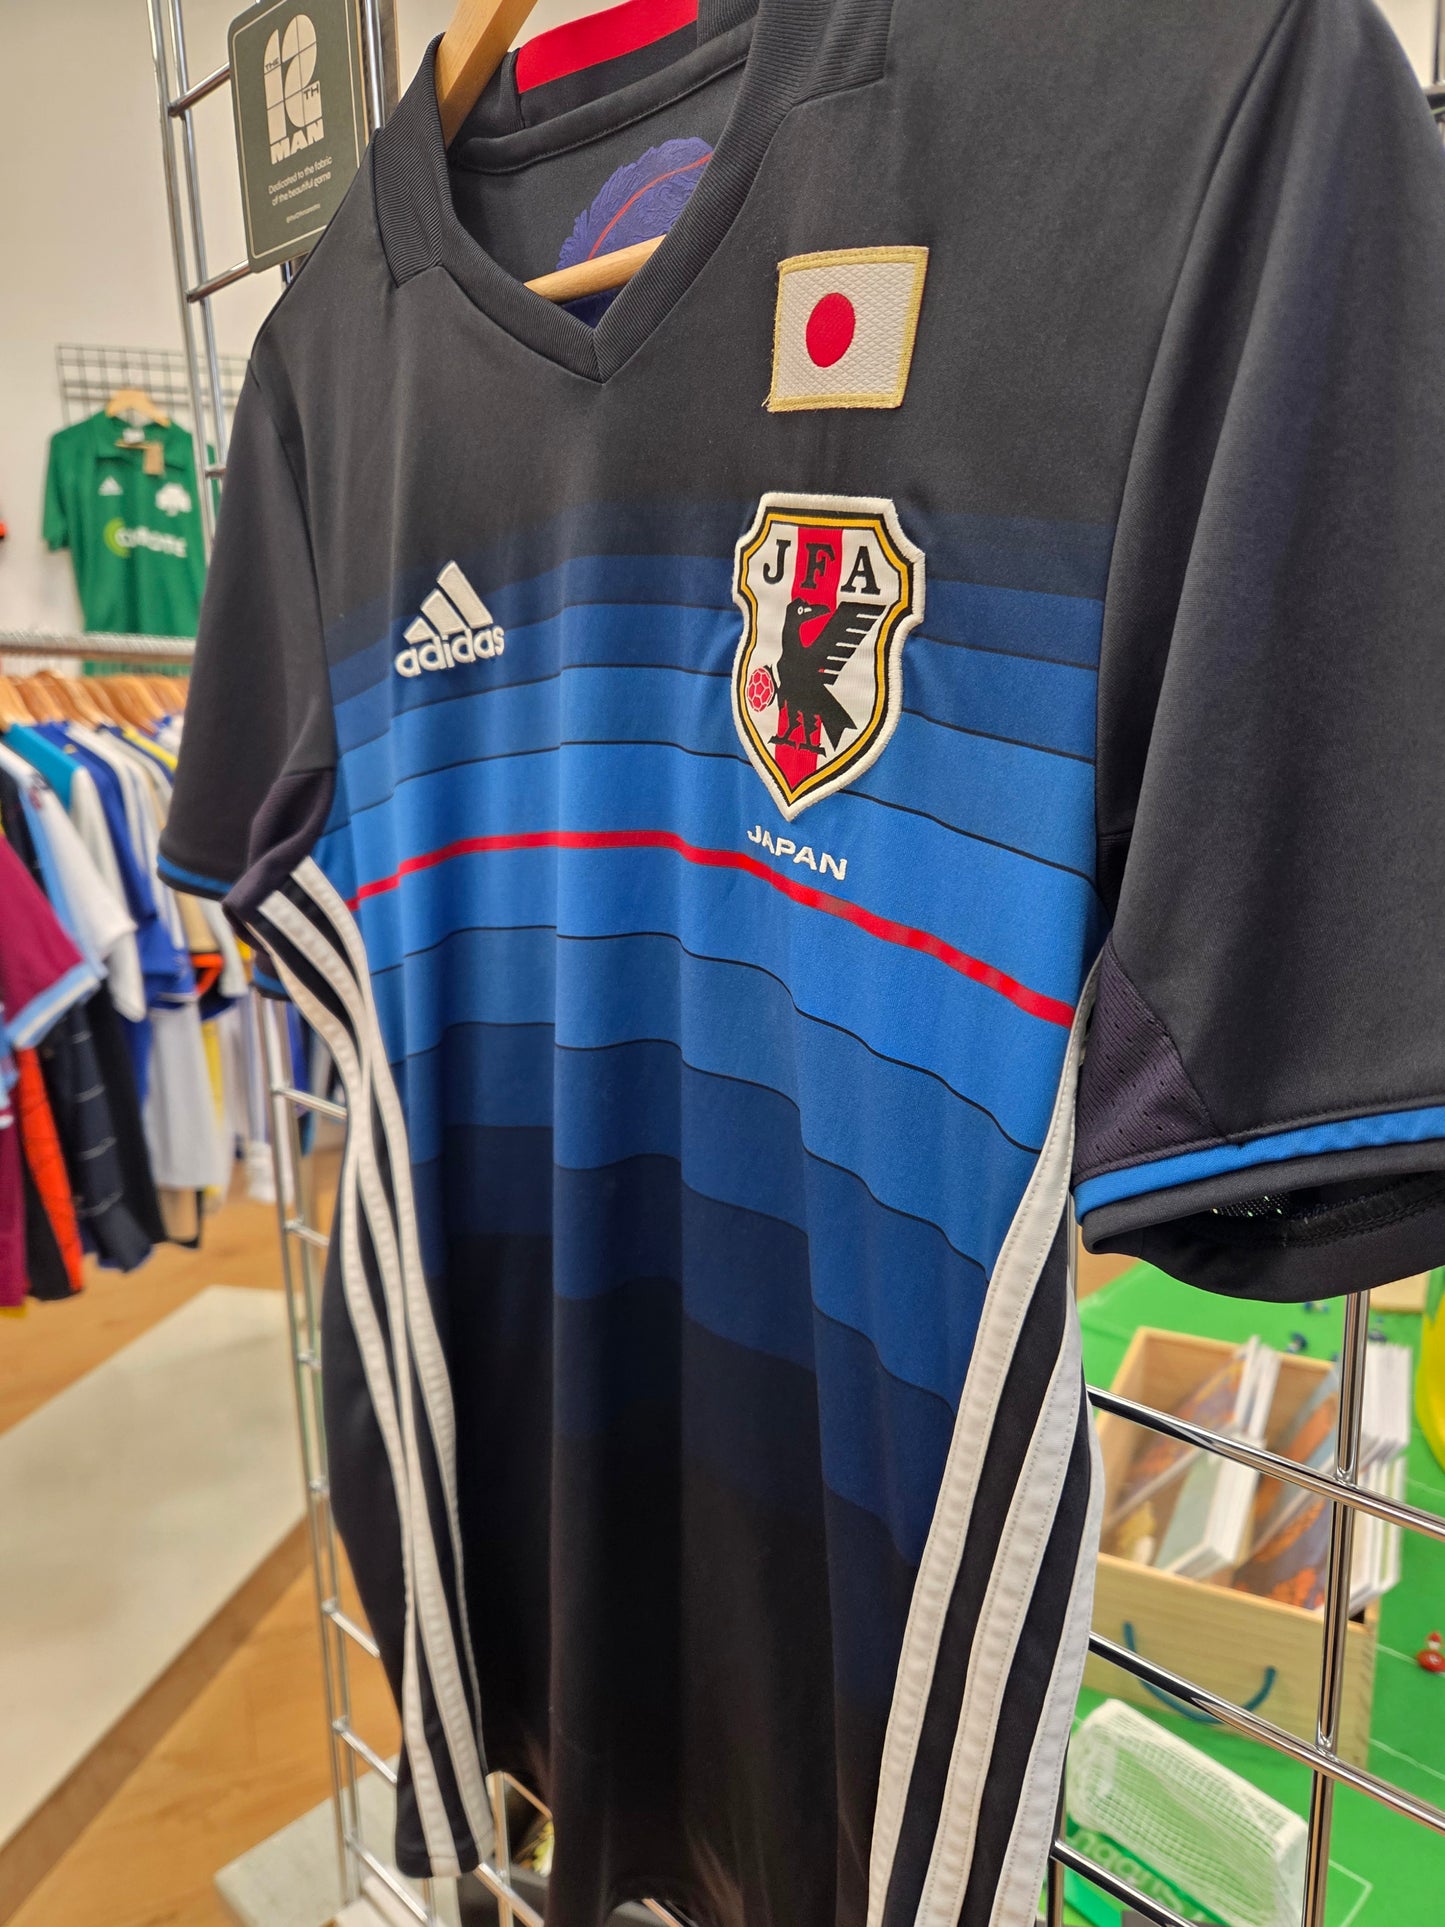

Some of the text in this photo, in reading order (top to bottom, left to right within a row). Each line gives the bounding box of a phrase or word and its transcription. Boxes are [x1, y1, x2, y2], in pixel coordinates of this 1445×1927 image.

[265, 57, 280, 71] THE
[304, 83, 320, 101] TH
[270, 118, 325, 165] MAN
[268, 172, 297, 194] Dedicated
[304, 165, 315, 176] the
[314, 155, 333, 171] fabric
[272, 171, 331, 206] of the beautiful game
[762, 538, 881, 596] JFA
[395, 625, 505, 678] adidas
[746, 824, 848, 882] JAPAN
